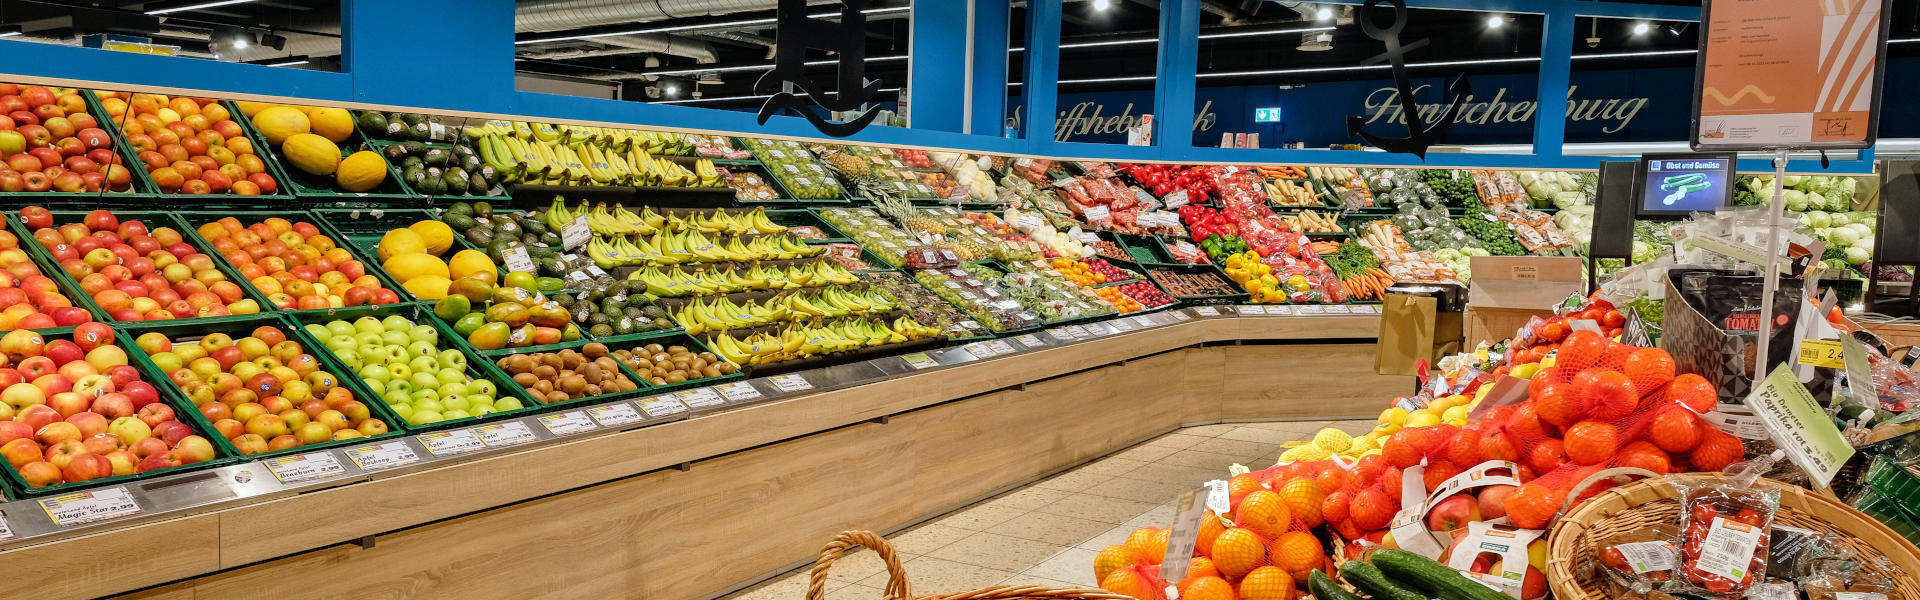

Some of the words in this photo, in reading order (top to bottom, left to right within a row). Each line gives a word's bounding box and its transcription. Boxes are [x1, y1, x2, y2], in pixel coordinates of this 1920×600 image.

[1694, 161, 1720, 169] Gemüse
[1724, 317, 1776, 331] TOMA
[1827, 348, 1844, 360] 2,4
[1766, 384, 1779, 398] Bio
[1778, 398, 1805, 430] Demeter
[1759, 390, 1793, 431] Paprika
[1792, 432, 1807, 447] rot
[1803, 446, 1829, 473] 3,49
[357, 454, 376, 462] Apfel
[279, 468, 316, 479] Braeburn
[57, 511, 88, 521] Magic
[89, 506, 109, 515] Star
[109, 503, 135, 512] 2,99
